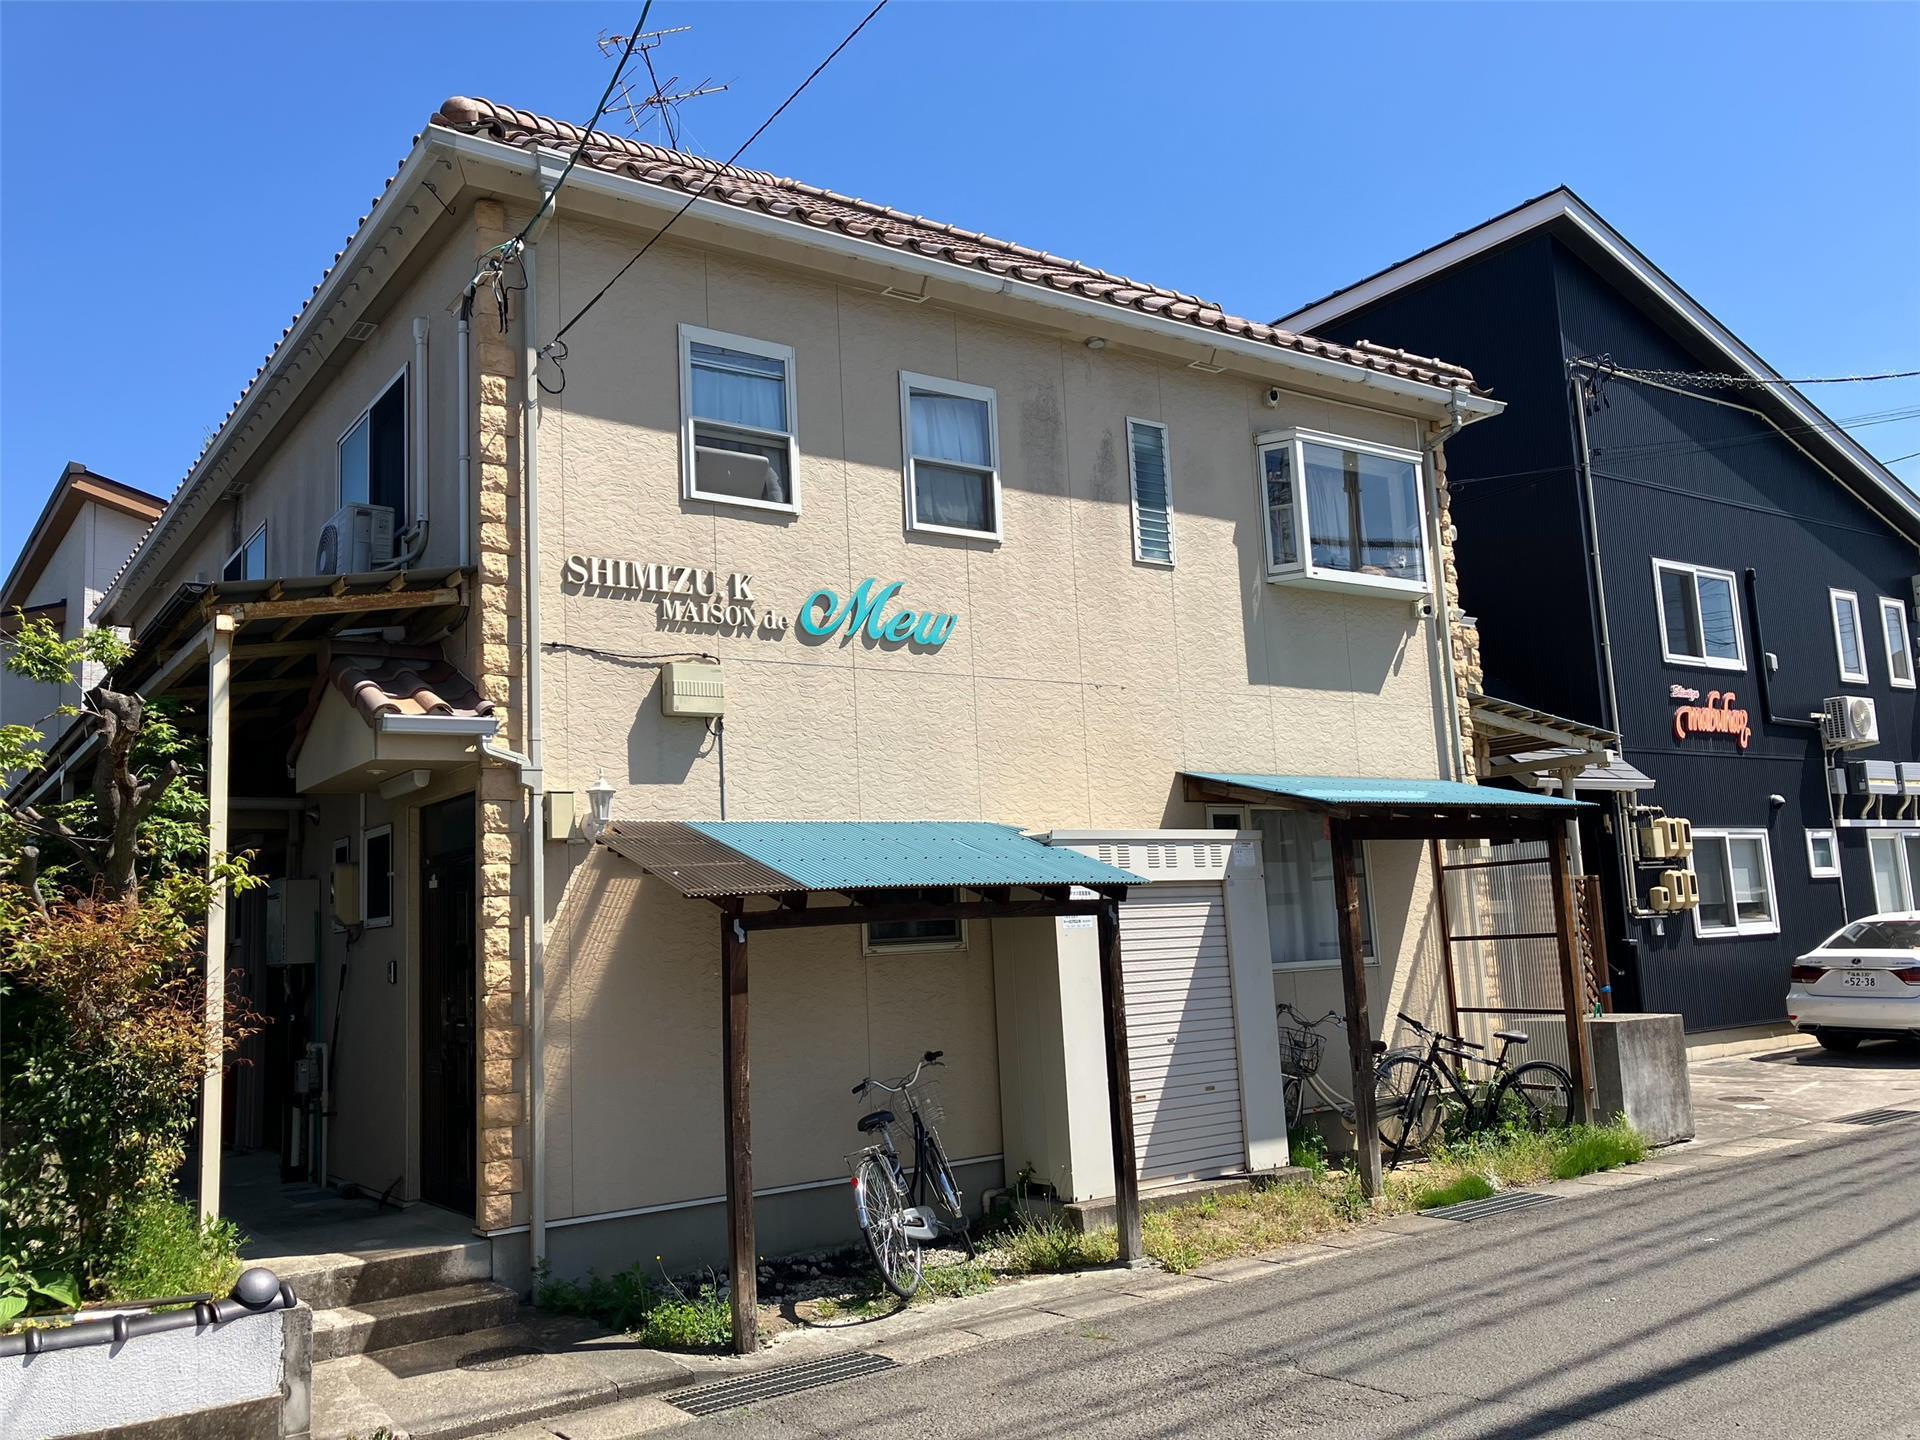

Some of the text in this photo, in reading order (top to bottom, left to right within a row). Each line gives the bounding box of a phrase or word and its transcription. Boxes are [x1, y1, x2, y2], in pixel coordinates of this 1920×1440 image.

[662, 577, 958, 645] MAISON de Mew
[1850, 977, 1875, 986] 52-38
